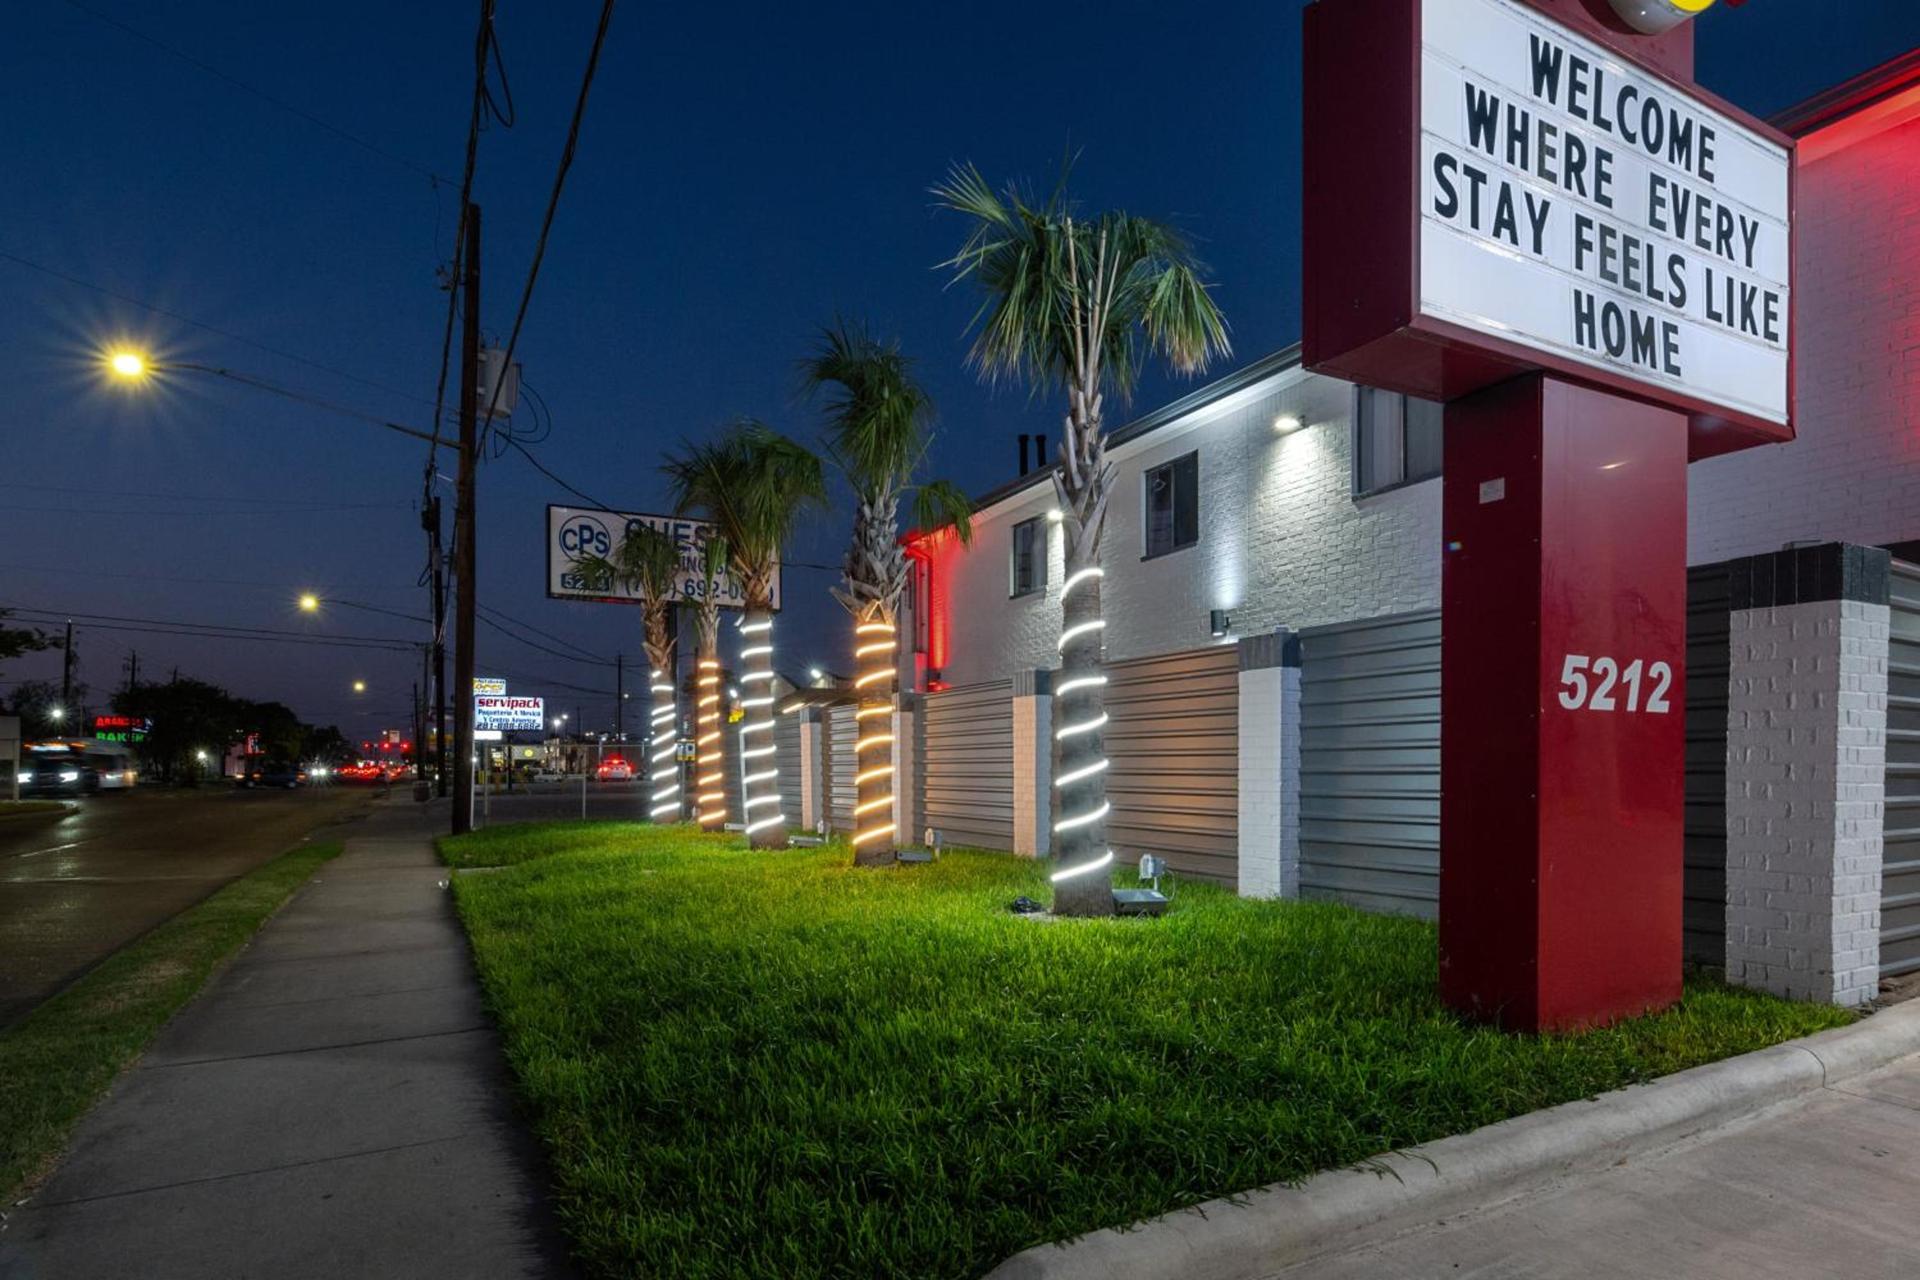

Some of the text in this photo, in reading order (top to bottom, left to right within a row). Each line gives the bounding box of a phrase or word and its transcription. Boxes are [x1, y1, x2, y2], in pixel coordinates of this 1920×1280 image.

[1529, 33, 1716, 184] WELCOME
[1464, 81, 1759, 268] WHERE EVERY
[1433, 151, 1780, 343] STAY FEELS LIKE
[1573, 288, 1682, 377] HOME
[562, 524, 609, 555] CPS
[478, 697, 541, 710] servipack
[1558, 654, 1672, 713] 5212
